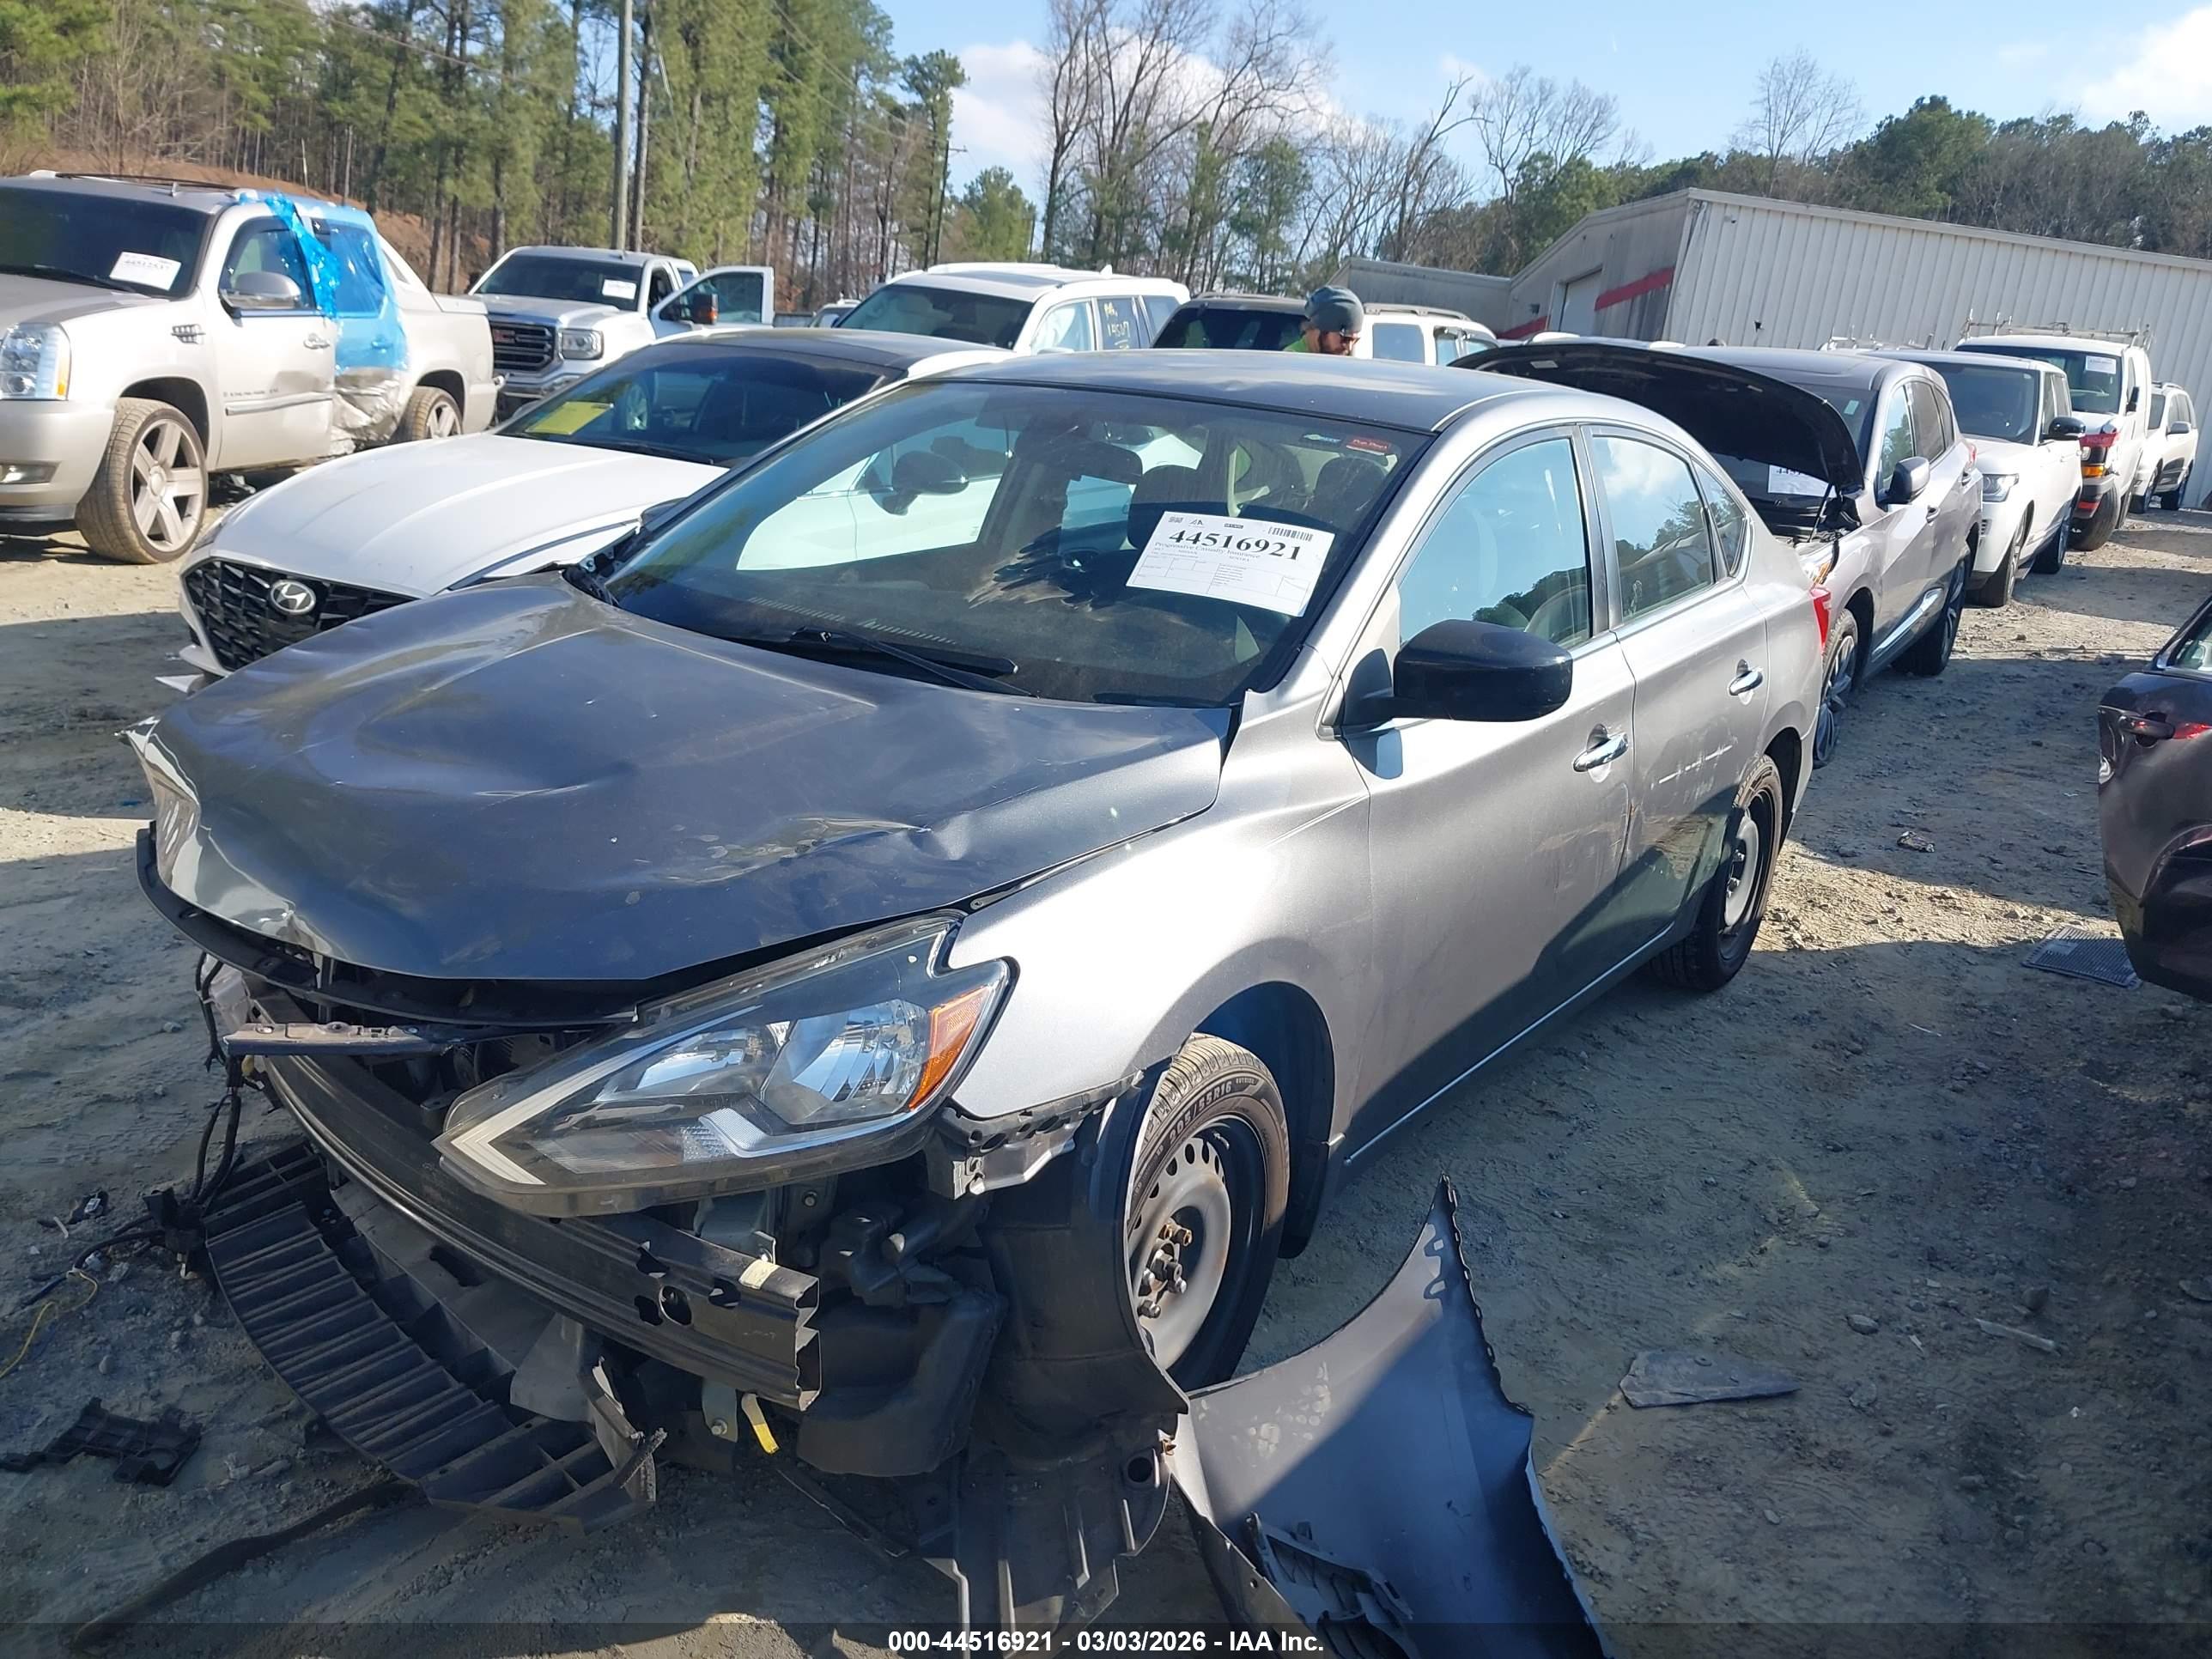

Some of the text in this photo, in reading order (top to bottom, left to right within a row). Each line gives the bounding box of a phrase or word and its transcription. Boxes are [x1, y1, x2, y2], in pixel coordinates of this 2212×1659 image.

[1155, 542, 1194, 550] Progressive
[1169, 530, 1301, 561] 44516921
[1170, 1080, 1232, 1144] 205/55R16
